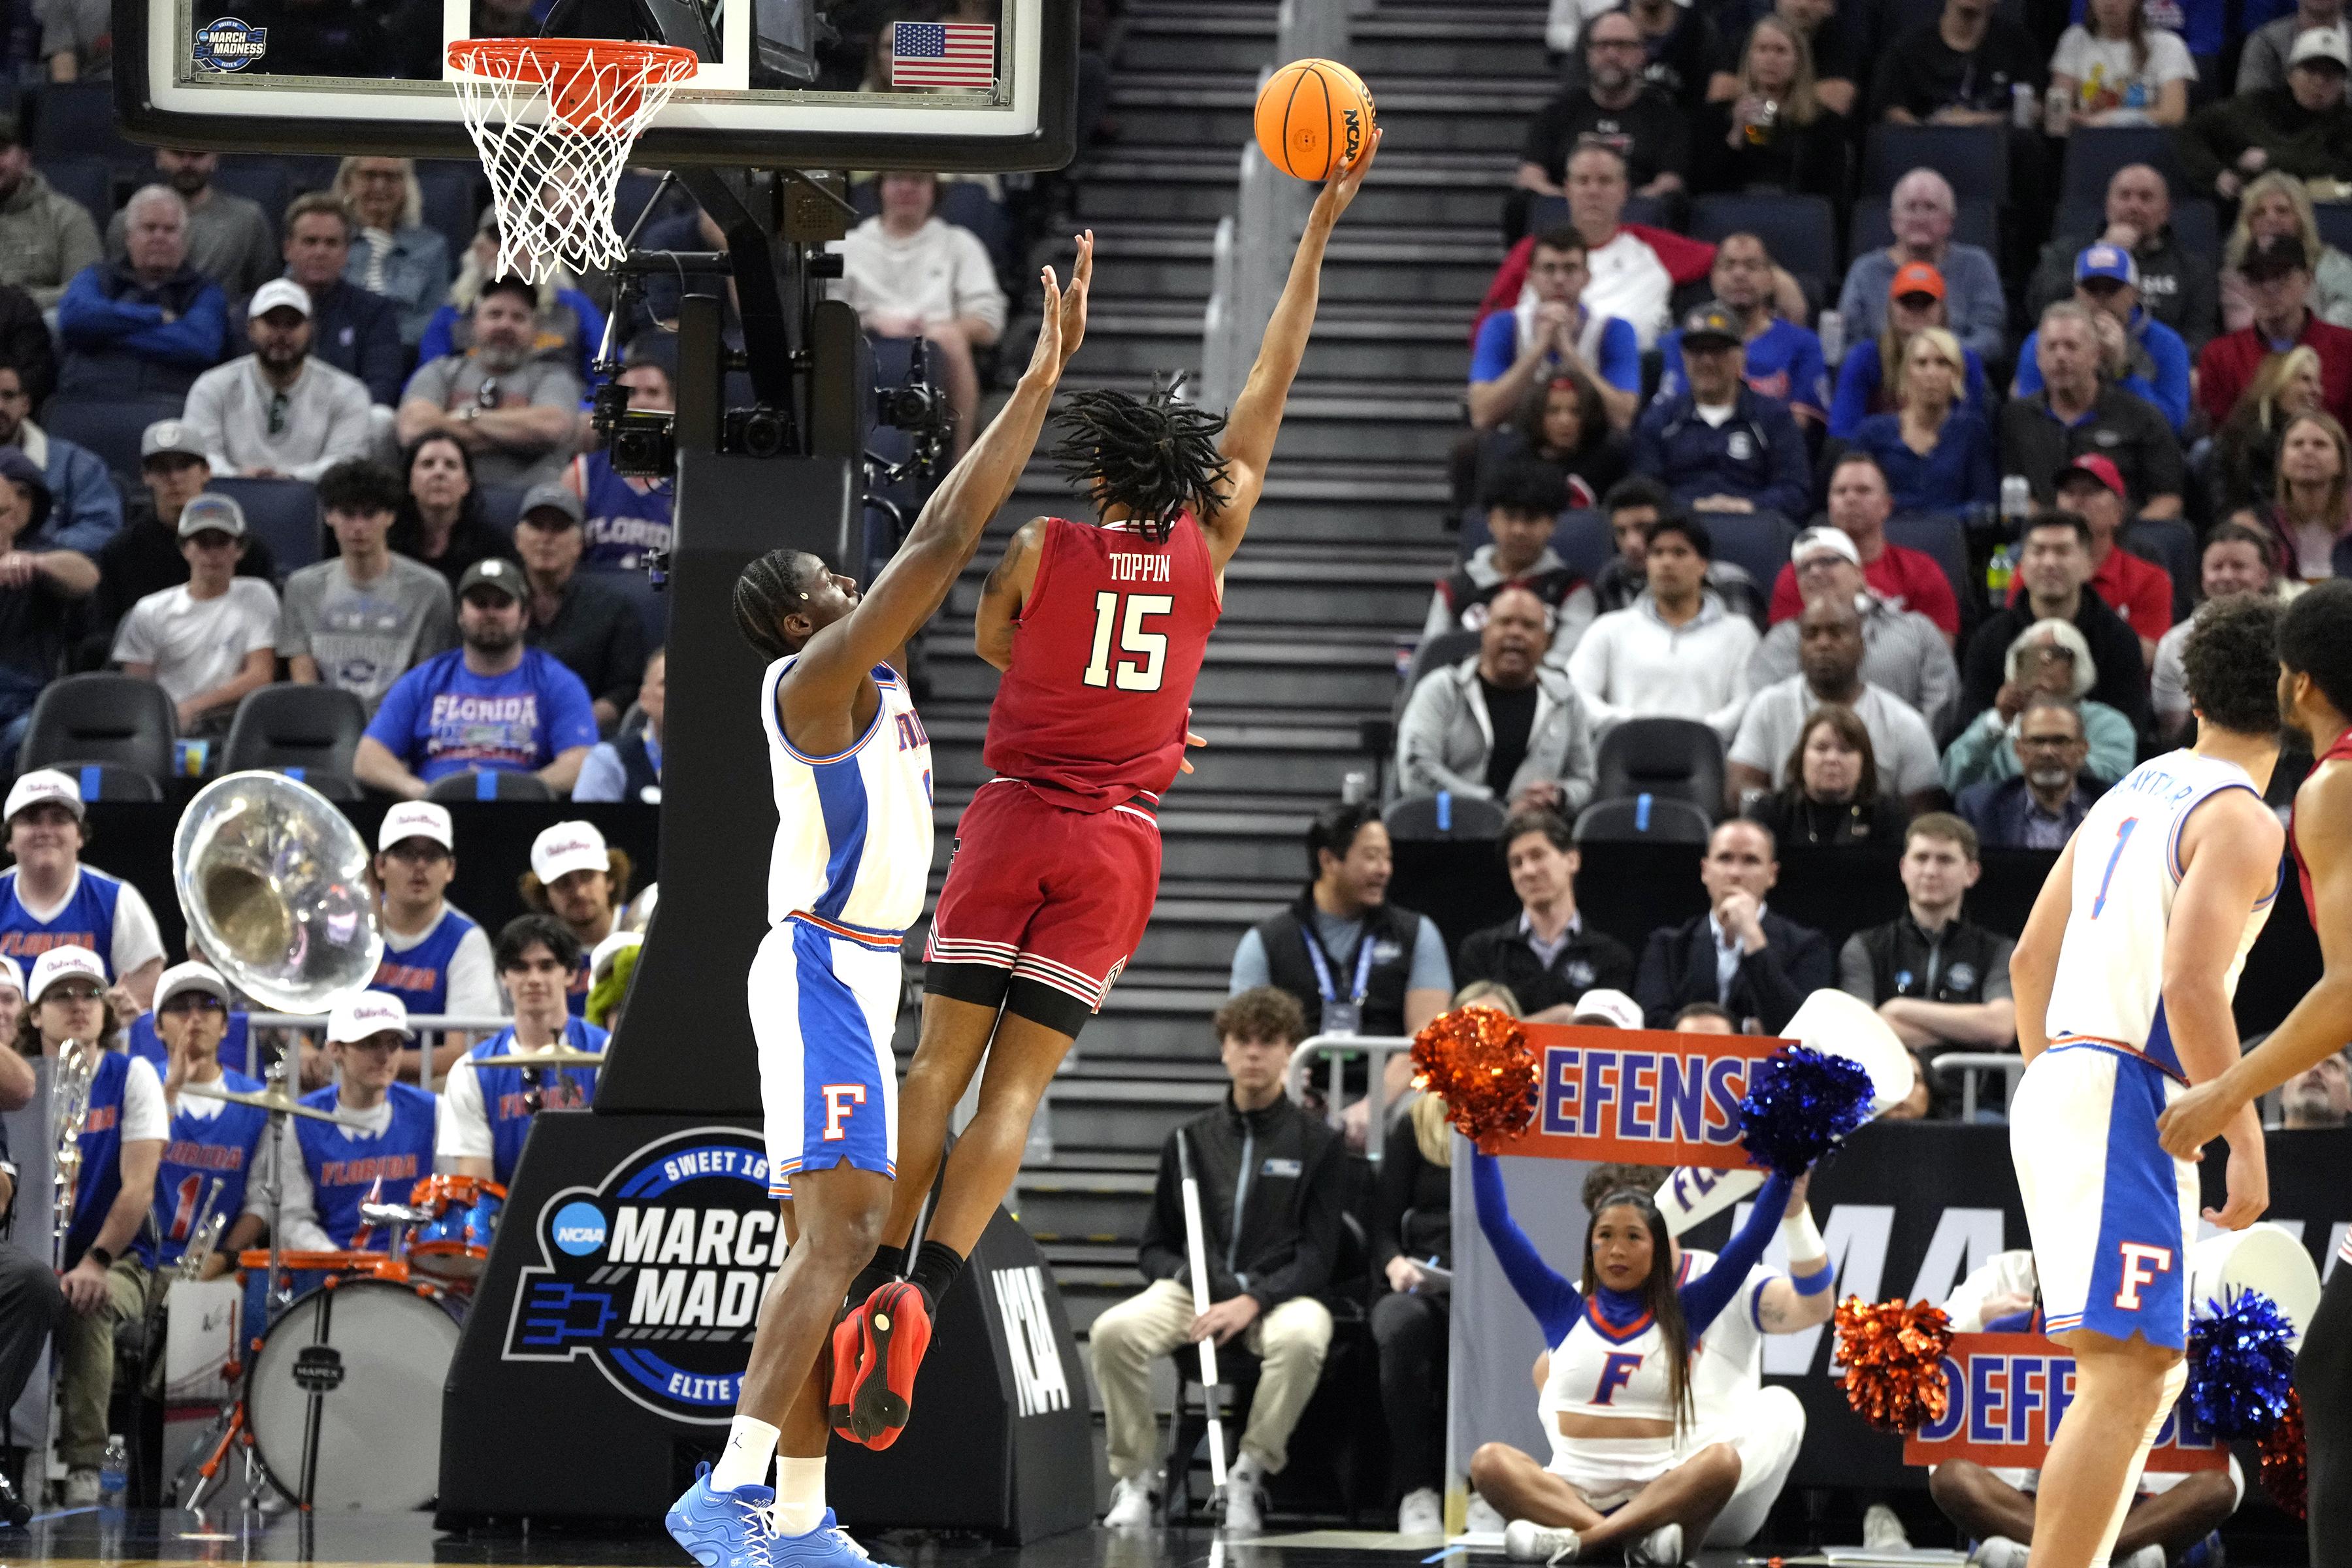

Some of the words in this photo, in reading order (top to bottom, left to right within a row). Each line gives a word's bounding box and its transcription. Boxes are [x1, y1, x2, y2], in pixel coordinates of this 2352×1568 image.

[209, 32, 246, 42] MARCH
[214, 43, 263, 54] MADNESS
[585, 516, 672, 555] FLORID
[1109, 553, 1171, 583] TOPPIN
[1081, 589, 1175, 693] 15
[429, 694, 538, 727] FLORIDA
[2091, 817, 2139, 920] 1
[821, 1083, 867, 1141] F
[1526, 1047, 1768, 1146] EFENS
[320, 1153, 417, 1187] FLORIDA
[664, 1151, 736, 1182] SWEET
[741, 1154, 769, 1179] 16
[175, 1173, 204, 1240] 1
[557, 1226, 606, 1243] NCAA
[2114, 1241, 2172, 1311] F
[667, 1372, 731, 1401] ELITE
[1586, 1351, 1644, 1407] F
